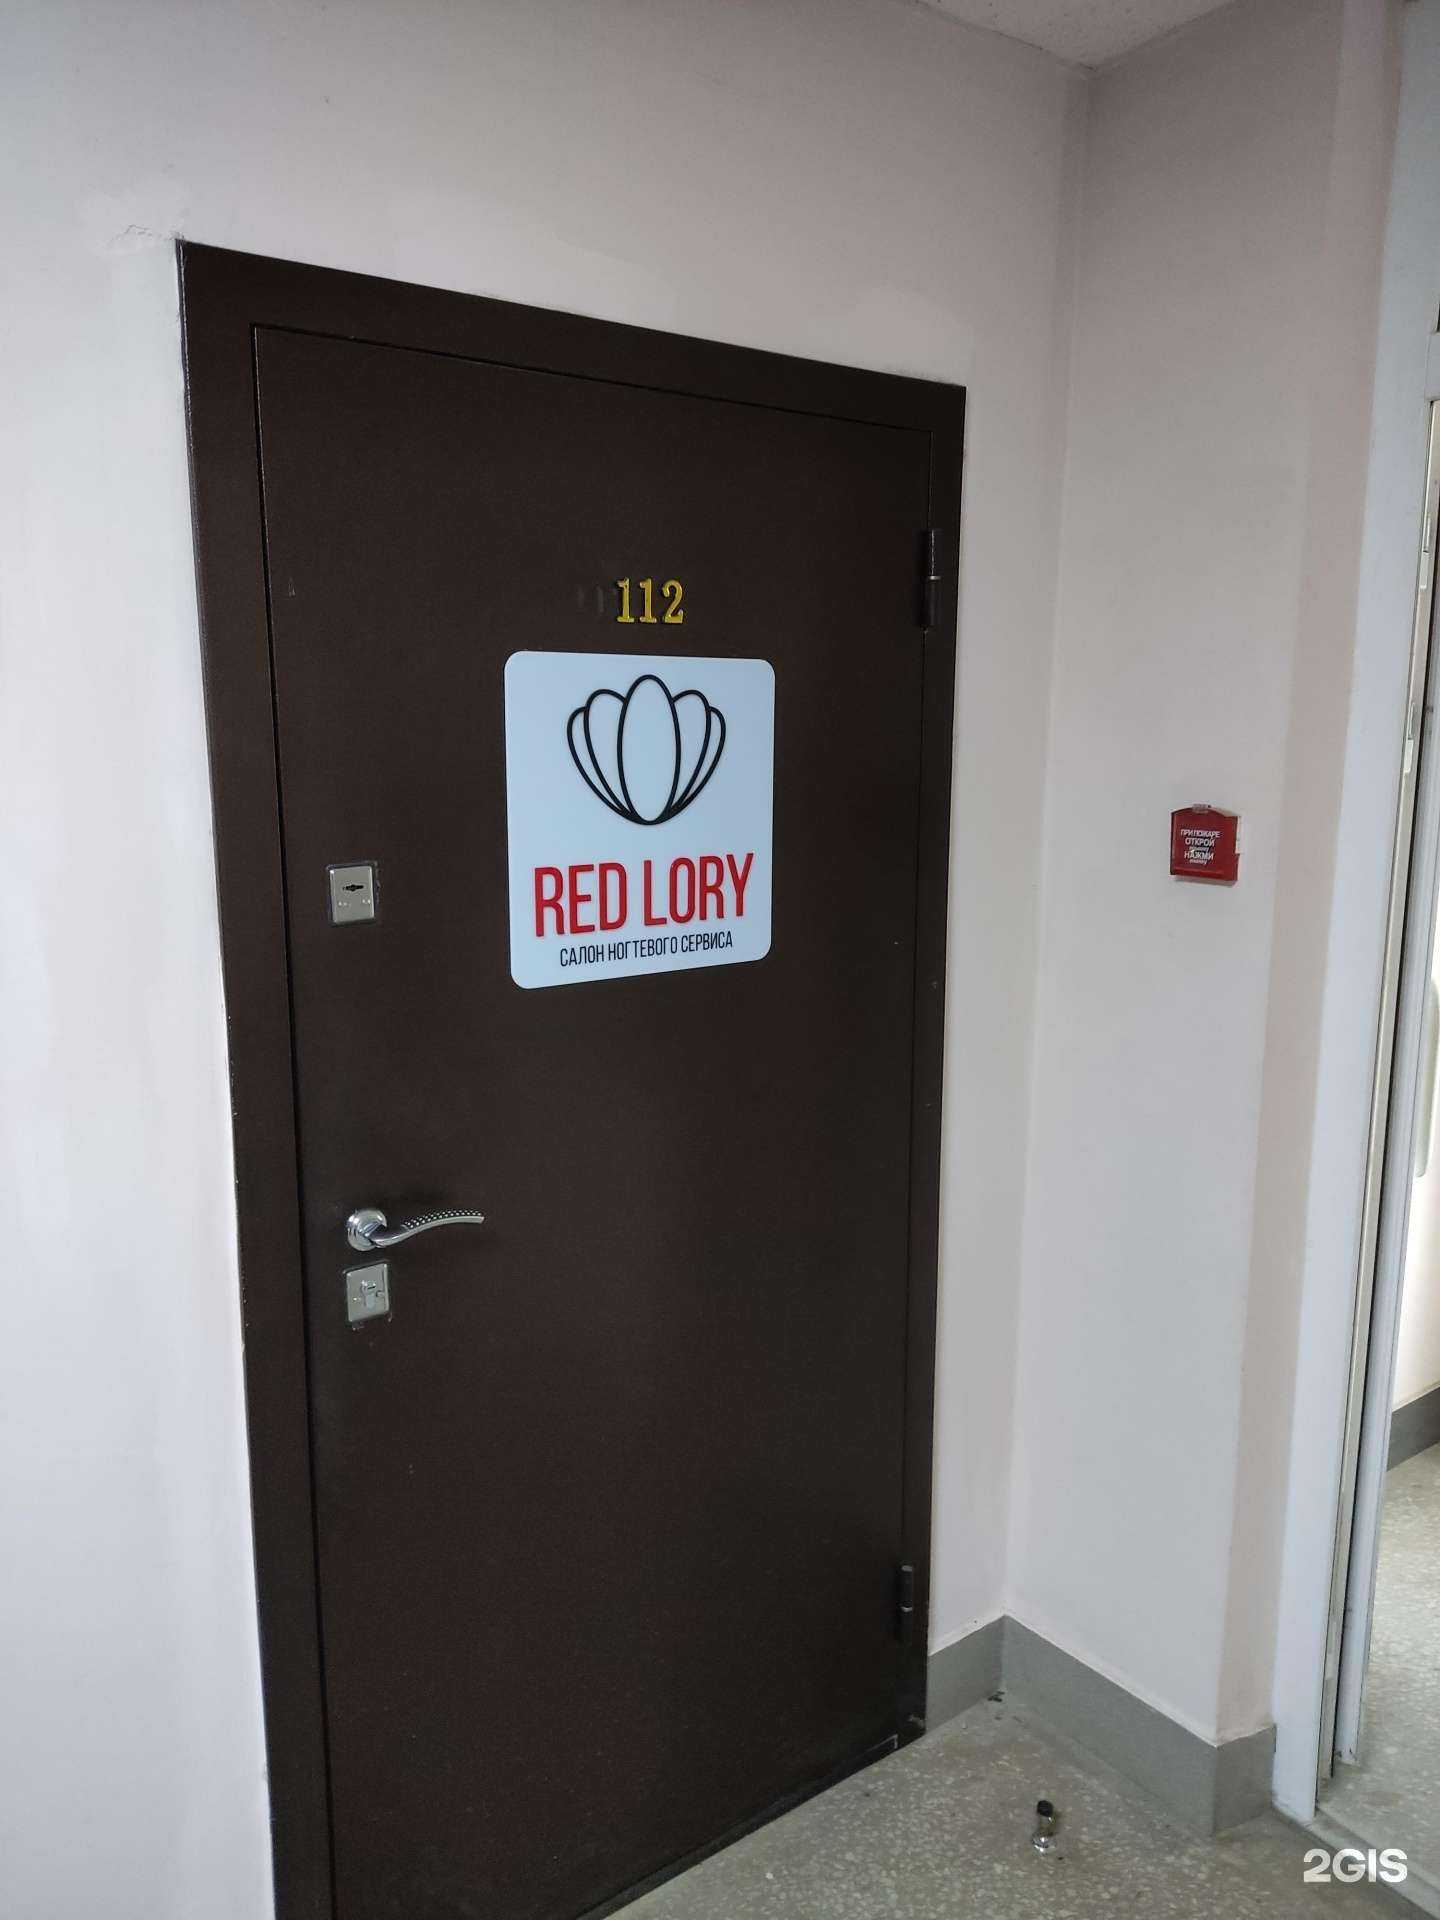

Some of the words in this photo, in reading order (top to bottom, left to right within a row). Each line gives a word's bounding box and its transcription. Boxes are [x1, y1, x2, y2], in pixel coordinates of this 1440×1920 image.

[616, 577, 684, 624] 112
[1180, 829, 1193, 837] ПРИ
[1185, 837, 1215, 847] ОТКРОЙ
[1184, 850, 1215, 860] НАЖМИ
[534, 862, 628, 938] RED
[643, 853, 754, 926] LORY
[560, 944, 605, 967] САЛОН
[608, 936, 678, 960] НОГТЕВОГО
[681, 930, 733, 953] СЕРВИСА
